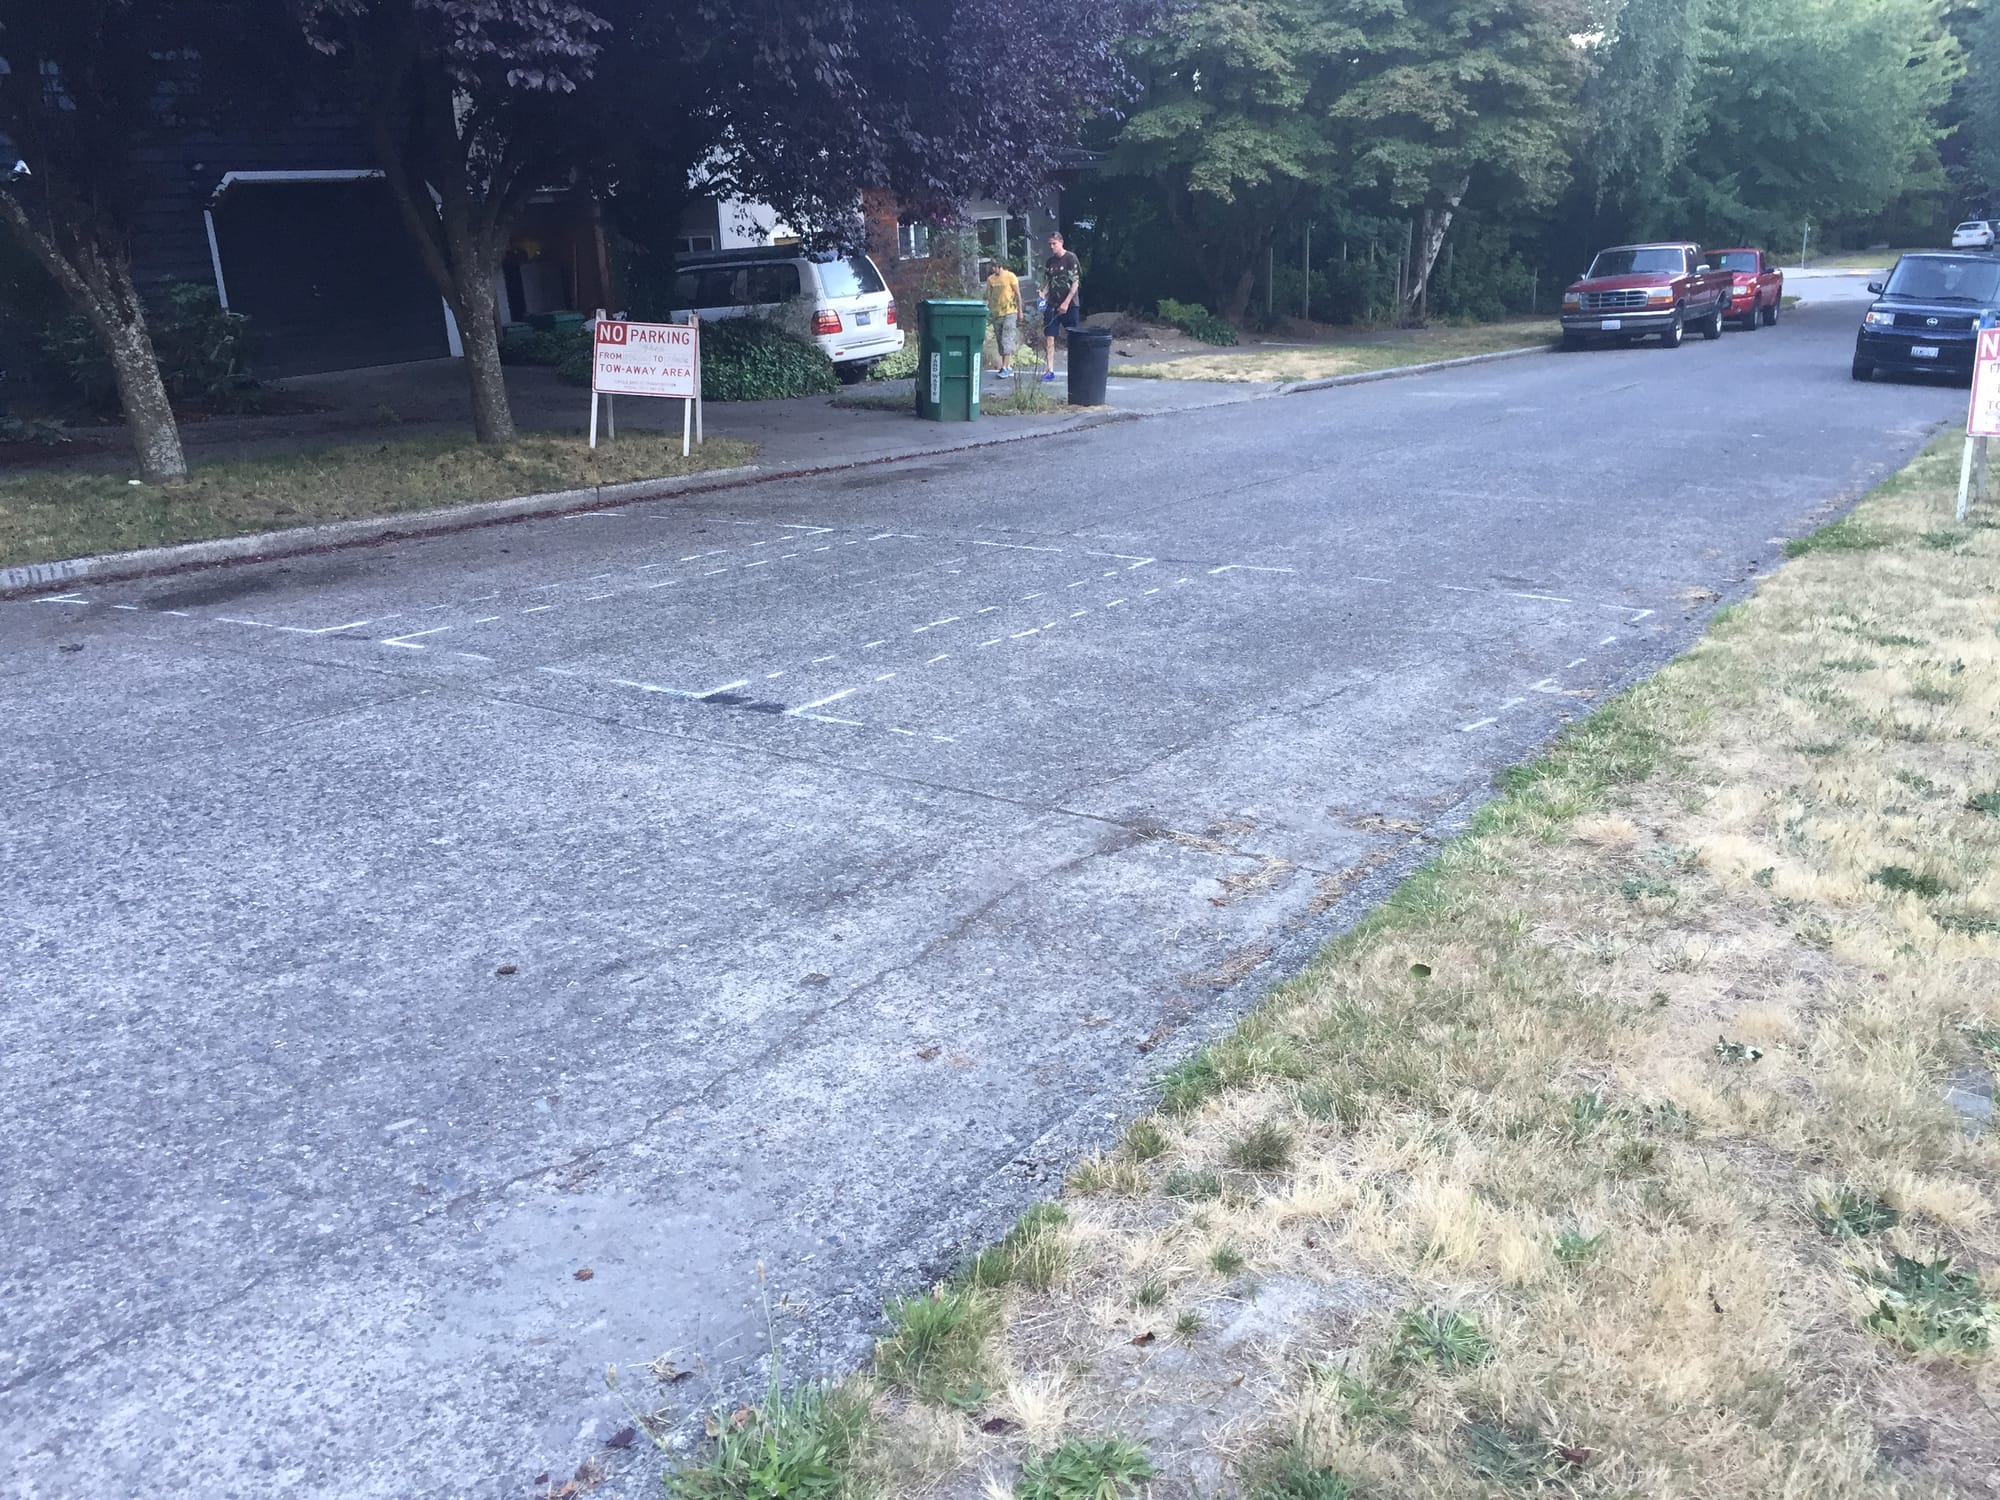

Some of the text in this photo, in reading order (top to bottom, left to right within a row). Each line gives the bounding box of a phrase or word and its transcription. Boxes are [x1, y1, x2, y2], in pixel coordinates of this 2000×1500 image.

[599, 324, 690, 346] NO PARKING
[599, 351, 622, 361] FROM
[653, 355, 664, 363] TO
[599, 363, 691, 377] TOW-AWAY AREA
